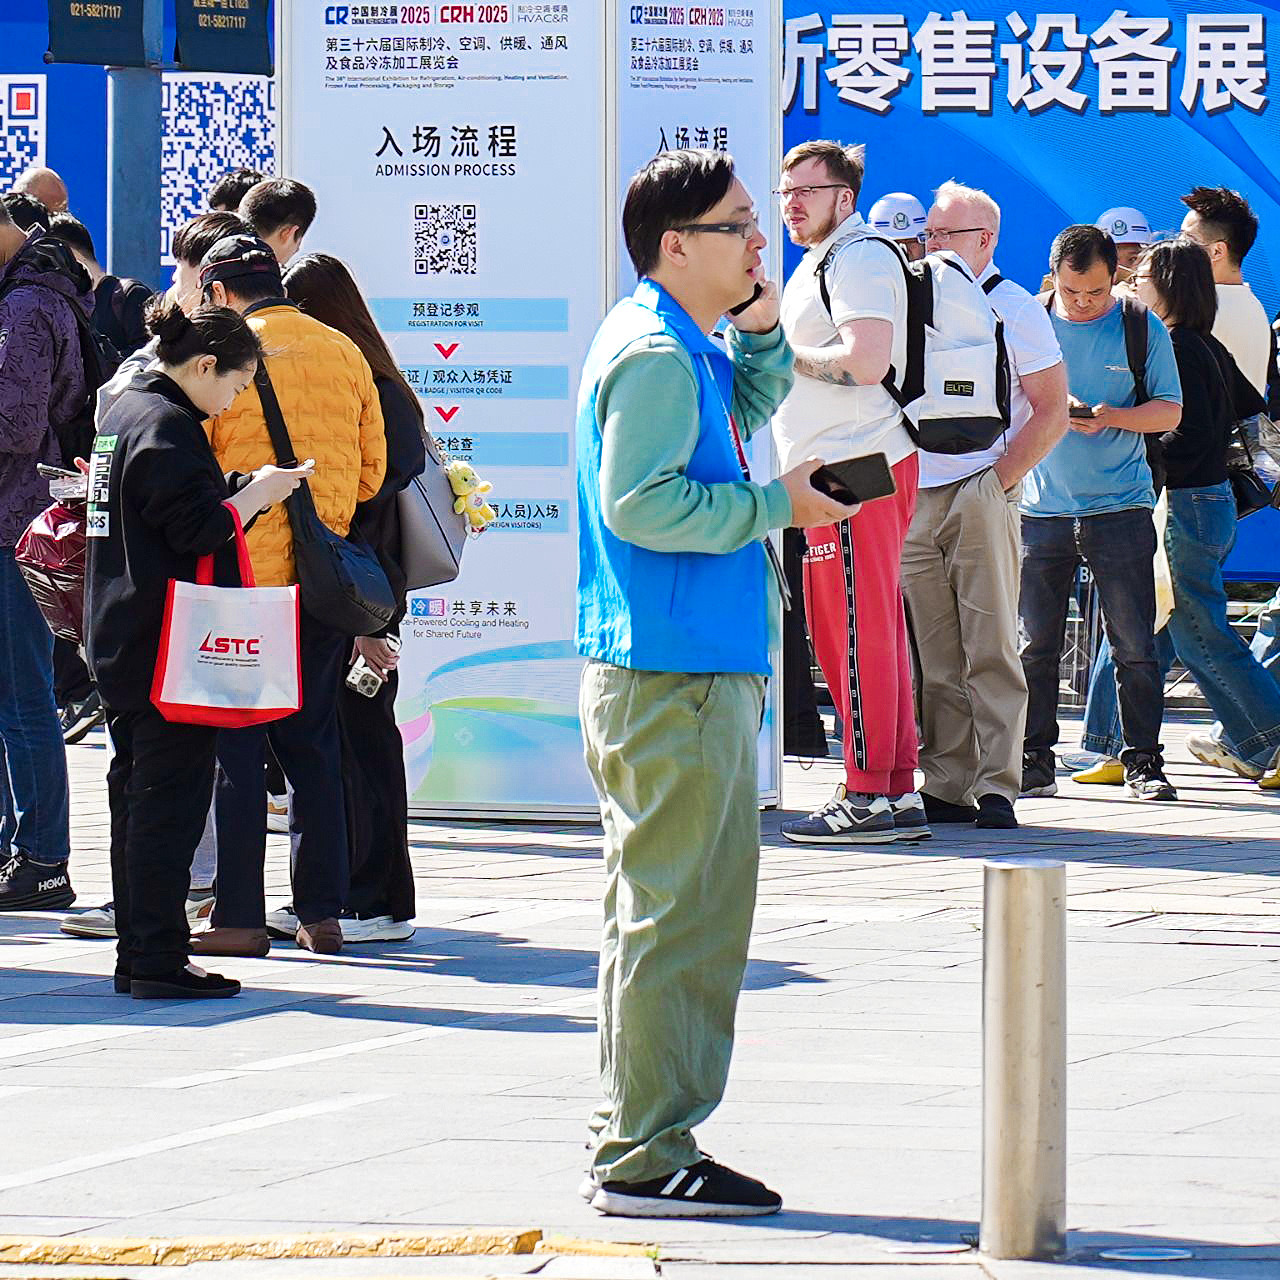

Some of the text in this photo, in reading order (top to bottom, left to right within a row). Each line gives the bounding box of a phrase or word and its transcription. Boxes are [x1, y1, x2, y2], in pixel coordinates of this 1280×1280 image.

[351, 6, 398, 17] 中国制冷展
[400, 6, 430, 24] 2025
[440, 5, 474, 23] CRH
[478, 5, 508, 23] 2025
[517, 14, 568, 23] HVAC&R
[669, 7, 684, 25] 2025
[708, 8, 724, 26] 2025
[325, 55, 459, 70] 及食品冷冻加工展览会
[374, 124, 518, 159] 入场流程
[375, 162, 517, 178] ADMISSION PROCESS
[413, 302, 480, 317] 预登记参观
[433, 370, 512, 384] 观众入场凭证
[452, 601, 518, 616] 共享未来
[449, 618, 529, 629] Cooling and Heating
[413, 629, 482, 638] for Shared Future
